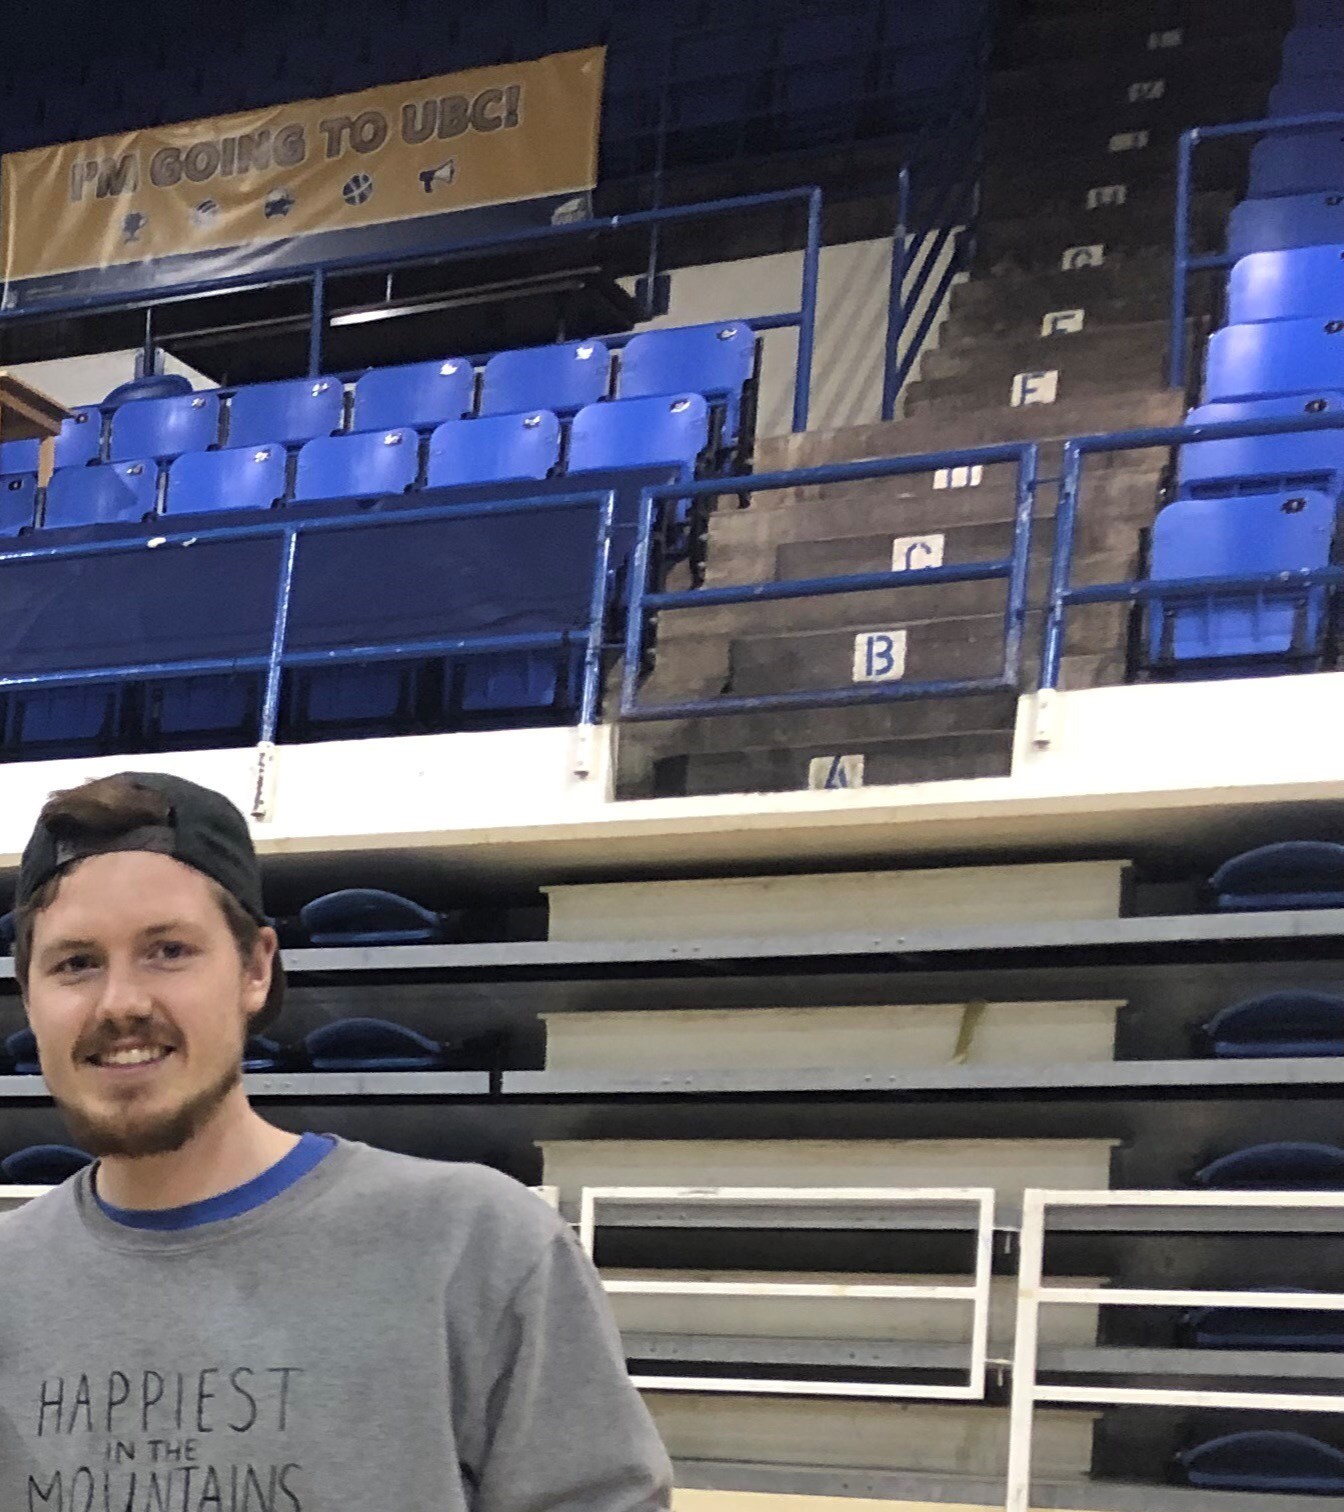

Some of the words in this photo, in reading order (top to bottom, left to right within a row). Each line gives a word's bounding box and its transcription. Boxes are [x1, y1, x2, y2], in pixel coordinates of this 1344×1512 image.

[70, 152, 139, 201] I'M
[149, 123, 308, 188] GOING
[319, 110, 390, 159] TO
[400, 85, 522, 145] UBC!
[865, 635, 894, 677] B
[37, 1366, 304, 1437] HAPPIEST
[104, 1441, 136, 1463] IN
[146, 1438, 199, 1462] THE
